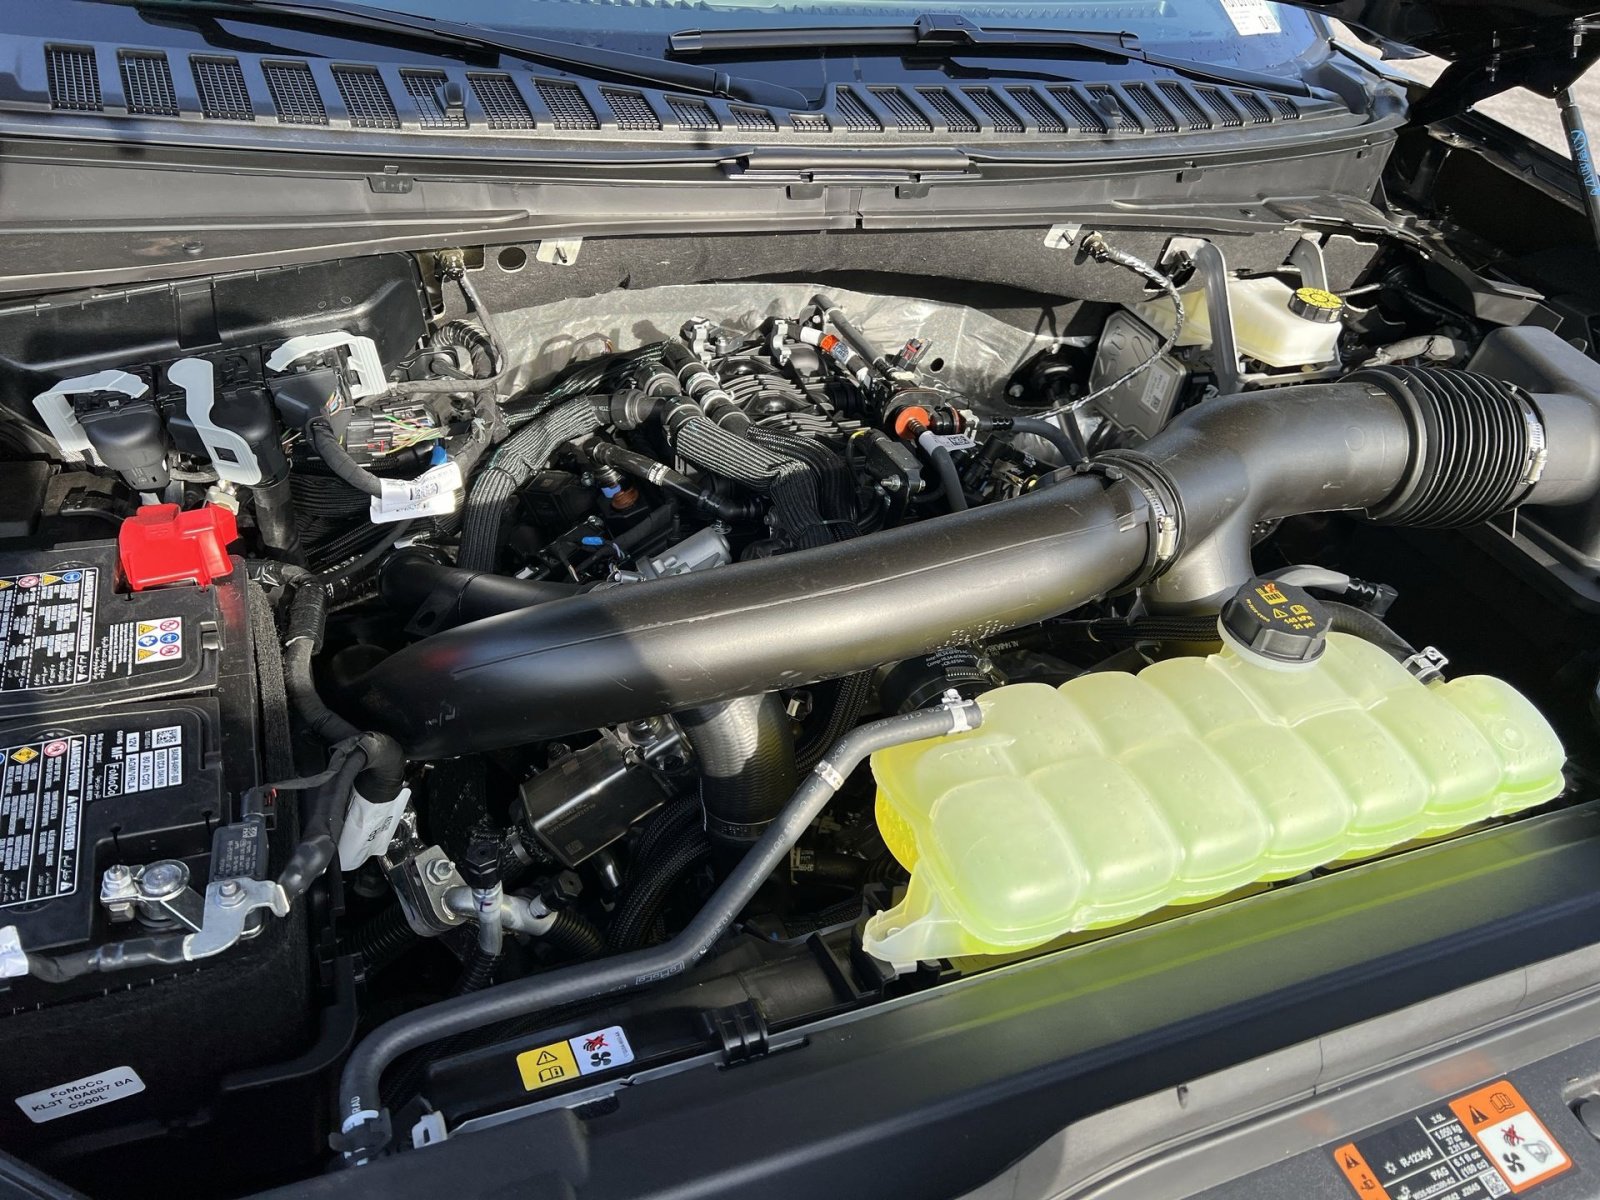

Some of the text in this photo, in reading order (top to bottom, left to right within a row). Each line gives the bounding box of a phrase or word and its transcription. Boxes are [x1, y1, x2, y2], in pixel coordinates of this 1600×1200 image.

[128, 736, 137, 748] 12V
[111, 746, 123, 760] MF
[107, 763, 119, 796] FoMoCo
[141, 773, 150, 786] C20
[31, 1077, 133, 1112] KL3T 10A687 BA
[50, 1079, 104, 1098] FoMoCo
[68, 1094, 108, 1110] C500L
[1452, 1123, 1463, 1134] kg
[1399, 1145, 1434, 1168] R-1234yf
[1453, 1156, 1466, 1168] 6.1
[1470, 1150, 1481, 1160] oz
[1476, 1158, 1490, 1171] cc)
[1430, 1165, 1450, 1181] PAG
